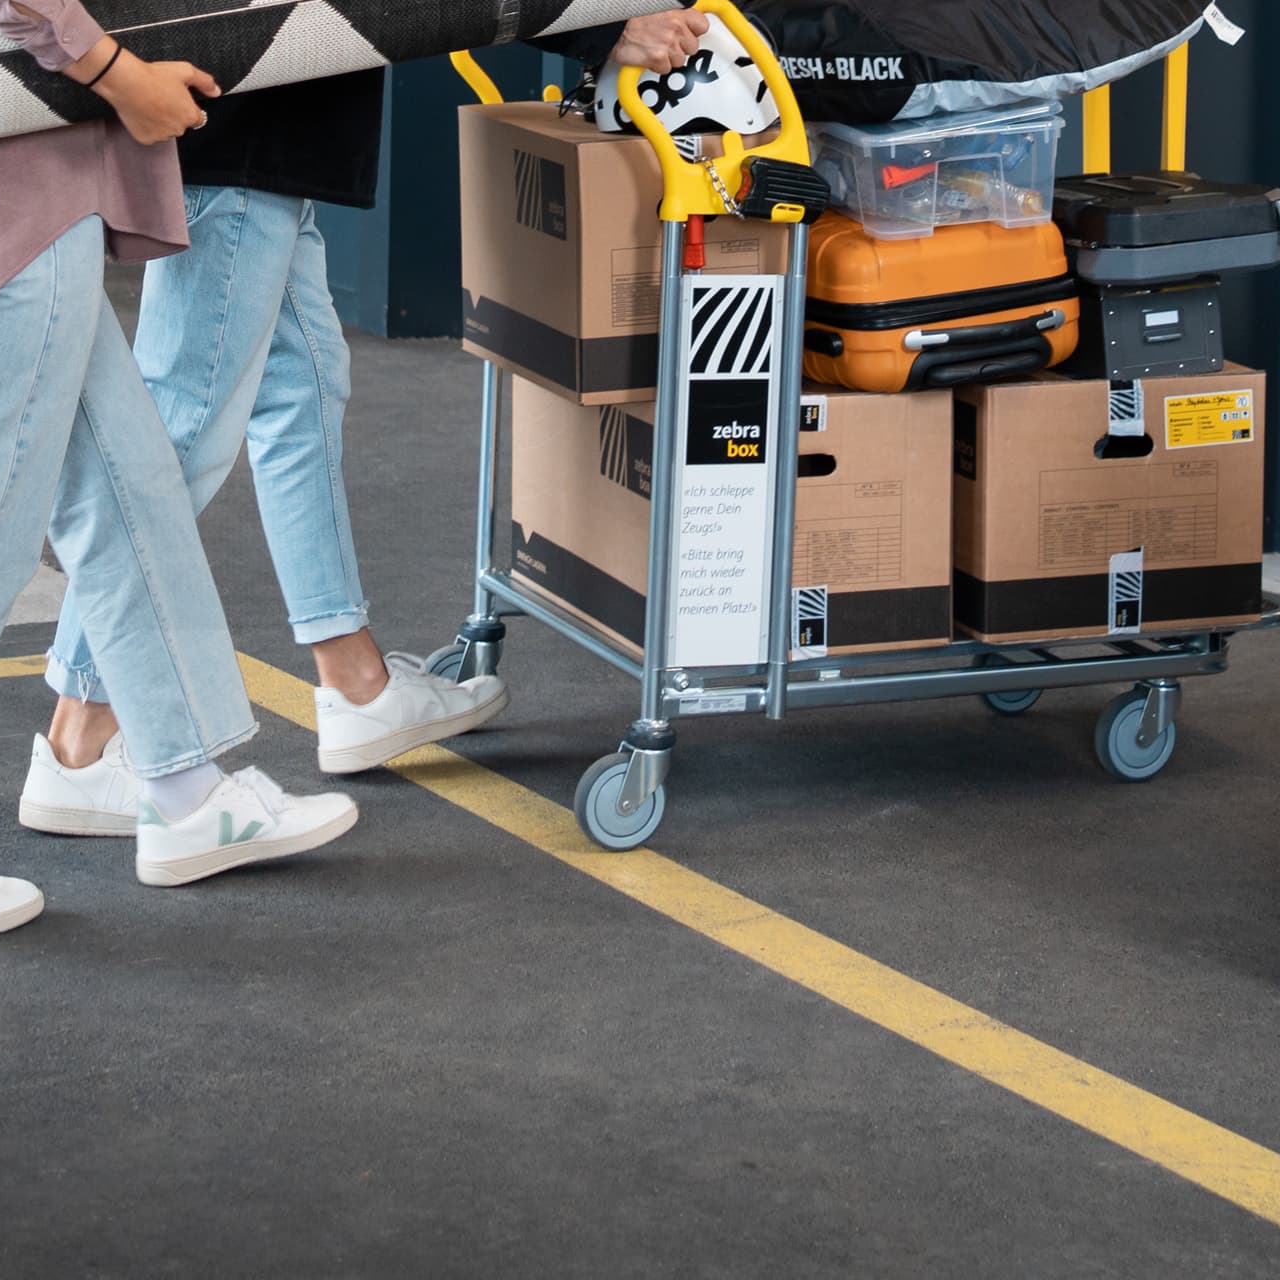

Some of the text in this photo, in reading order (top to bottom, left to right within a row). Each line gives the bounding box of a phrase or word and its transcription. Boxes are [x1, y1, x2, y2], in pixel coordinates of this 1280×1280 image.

[779, 56, 905, 81] RESH & BLACK
[712, 420, 760, 439] zebra
[727, 440, 759, 458] box
[684, 484, 755, 501] «Ich schleppe
[683, 503, 742, 518] gerne Dein
[681, 521, 723, 537] Zeugs!»
[681, 549, 744, 564] «Bitte bring
[680, 566, 745, 579] mich wieder
[679, 584, 732, 598] zurück an
[679, 601, 758, 616] meinen Platz!»
